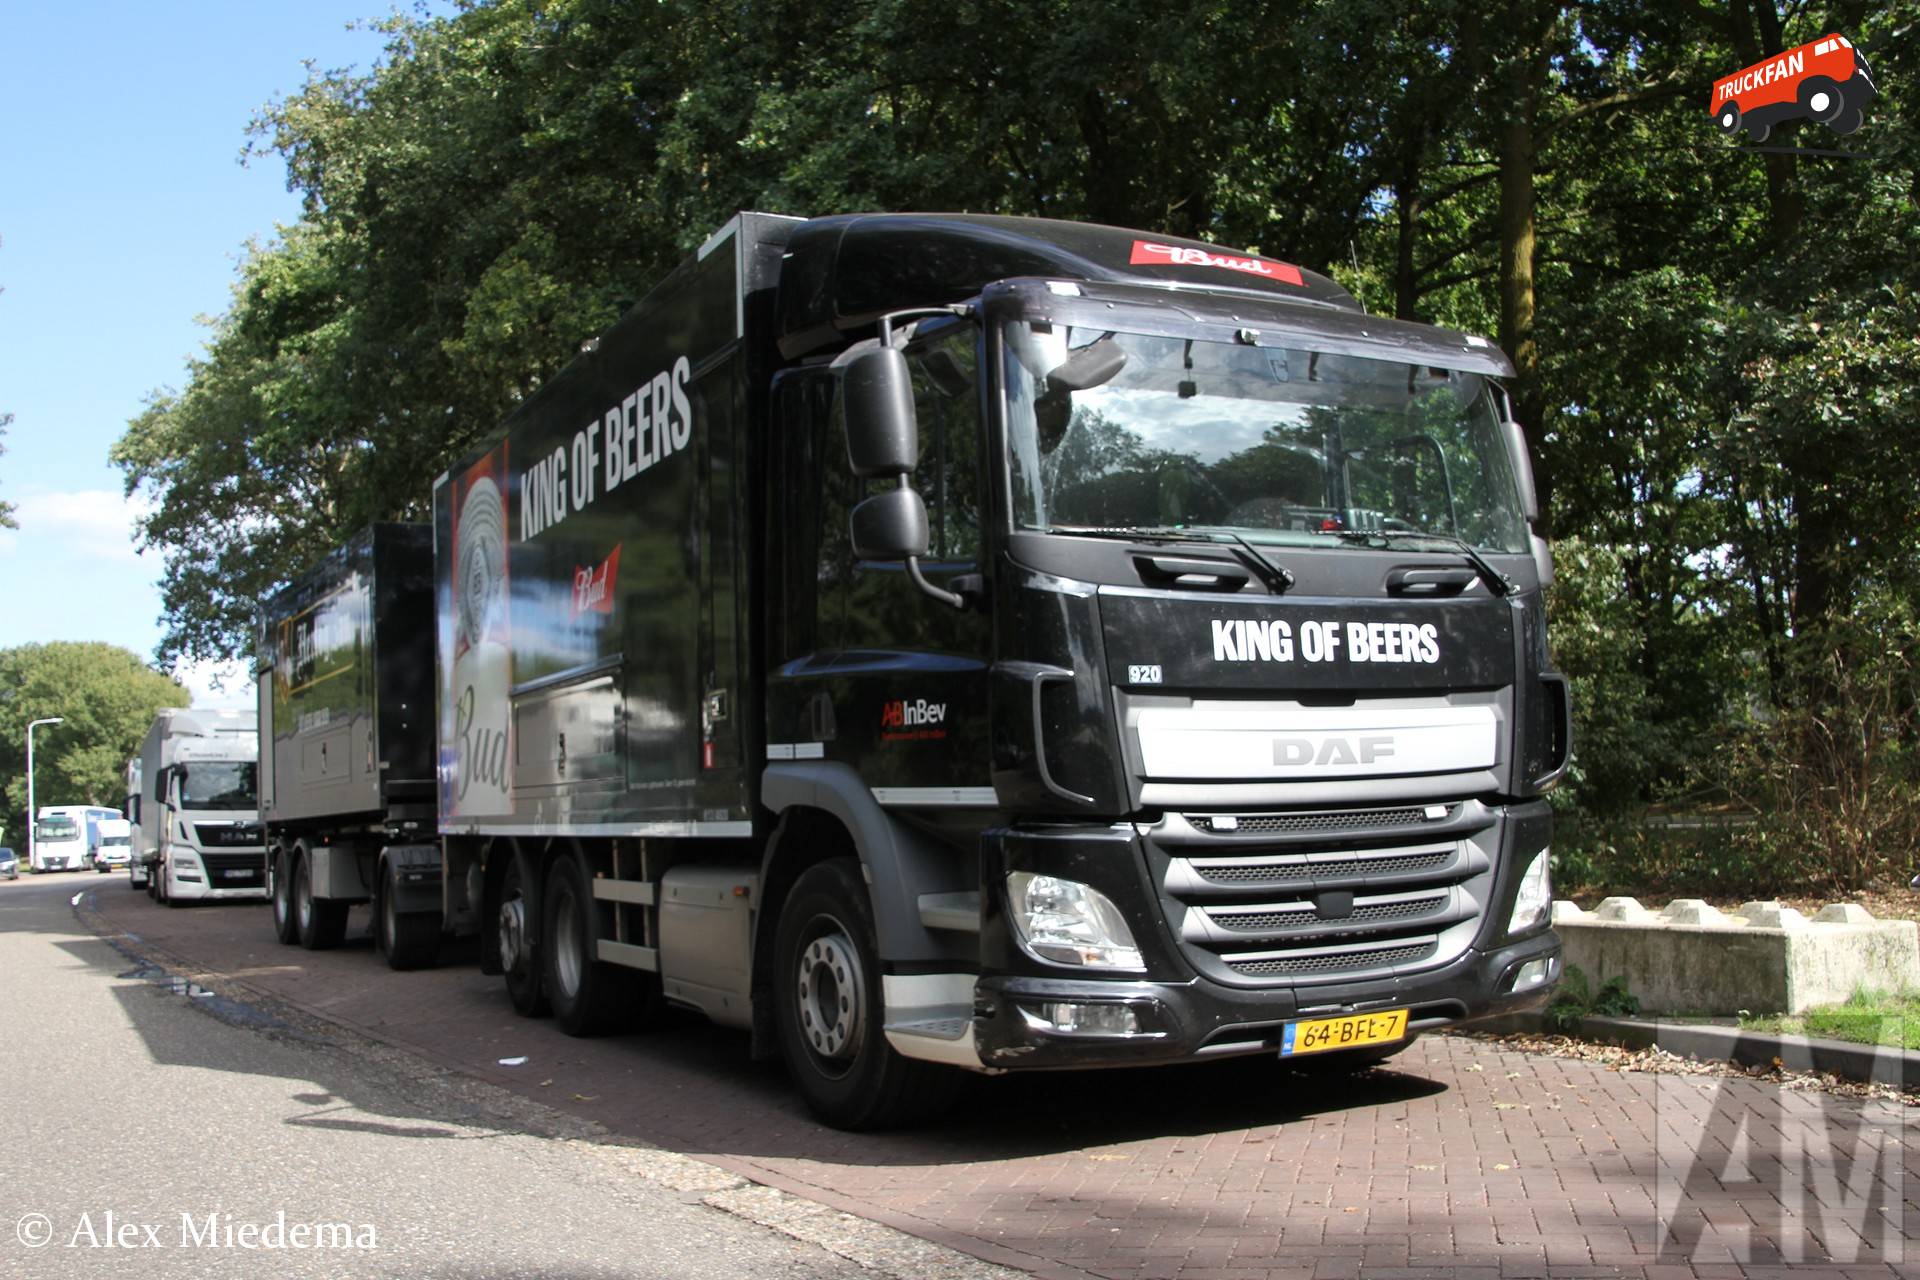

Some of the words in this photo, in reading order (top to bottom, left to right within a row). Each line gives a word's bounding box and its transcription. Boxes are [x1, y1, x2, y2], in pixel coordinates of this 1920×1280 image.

[1143, 243, 1272, 274] Bud
[520, 446, 567, 543] KING
[571, 419, 600, 512] OF
[605, 355, 692, 493] BEERS
[576, 560, 609, 612] Bud
[1211, 619, 1294, 662] KING
[1300, 620, 1340, 662] OF
[1348, 622, 1440, 664] BEERS
[1130, 666, 1161, 683] 920
[455, 684, 511, 803] Bud
[1272, 736, 1396, 767] DAF
[1303, 1015, 1399, 1048] 64-BFL-7
